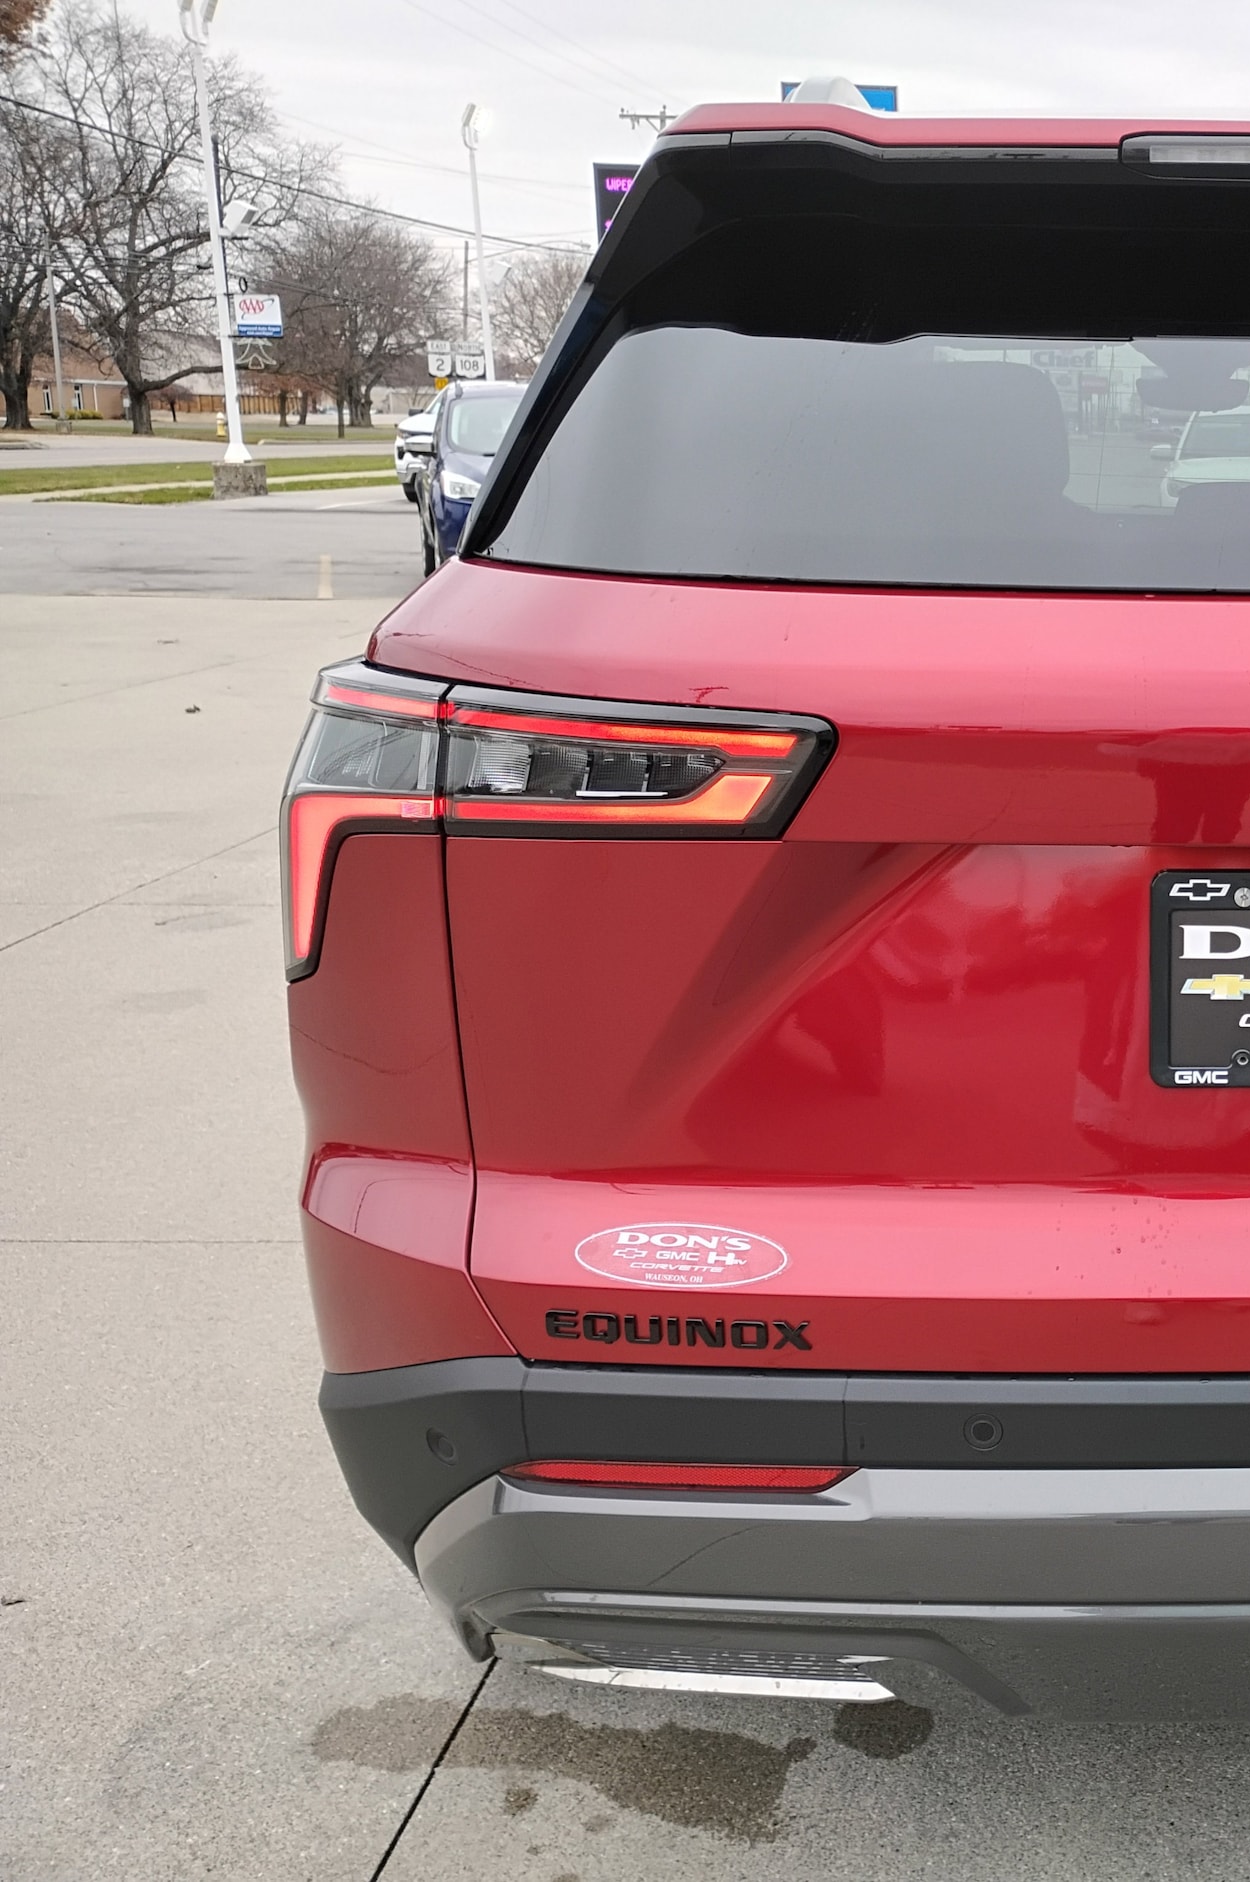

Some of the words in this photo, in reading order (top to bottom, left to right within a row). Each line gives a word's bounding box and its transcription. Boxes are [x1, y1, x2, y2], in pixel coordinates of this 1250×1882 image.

[240, 298, 264, 314] AAA
[435, 358, 445, 371] 2
[460, 360, 479, 371] 108
[1174, 1070, 1228, 1085] GMC
[616, 1231, 751, 1251] DON'S
[655, 1251, 700, 1262] GMC
[629, 1262, 726, 1273] CORVETTE
[645, 1273, 688, 1283] WAUSEON,
[690, 1275, 703, 1283] OH
[545, 1309, 813, 1350] EQUINOX
